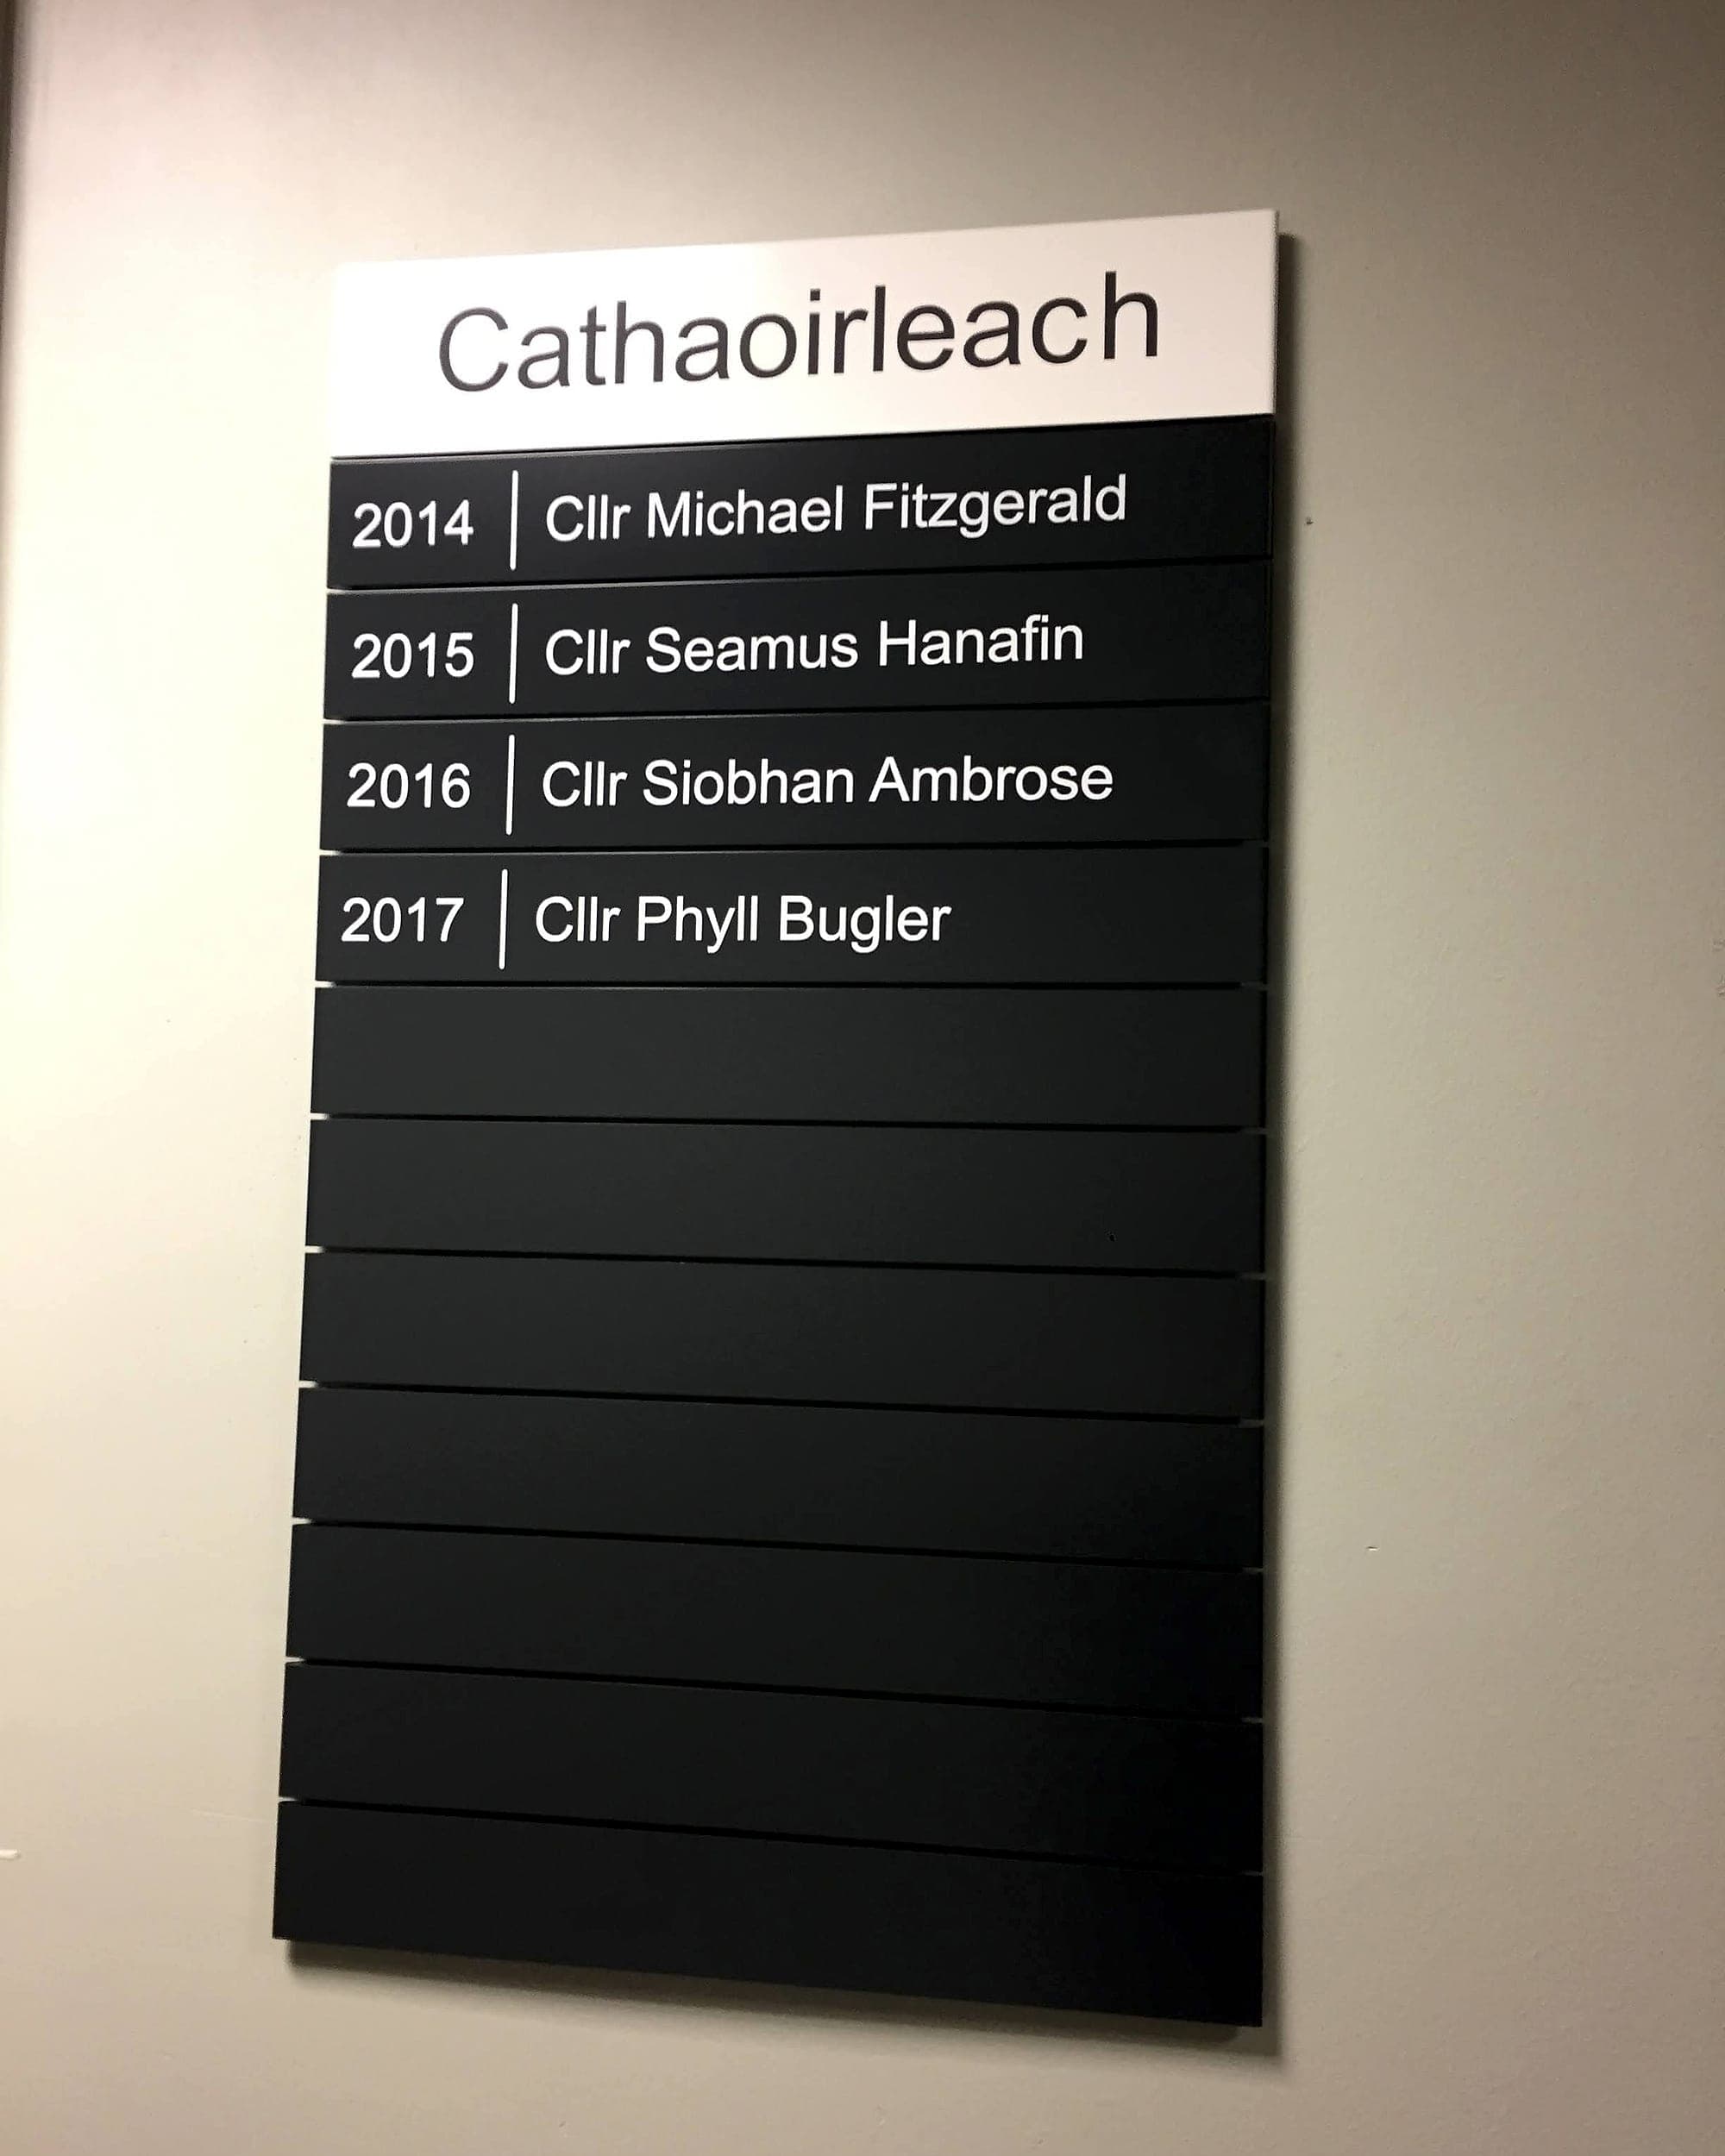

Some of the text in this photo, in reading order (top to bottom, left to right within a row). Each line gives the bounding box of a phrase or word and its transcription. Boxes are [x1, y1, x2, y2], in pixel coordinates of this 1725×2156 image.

[438, 270, 1159, 392] Cathaoirleach
[352, 473, 1126, 549] 2014 Cllr Michael Fitzgerald
[351, 613, 1083, 679] 2015 Cllr Seamus Hanafin
[346, 755, 1113, 810] 2016 Cllr Siobhan Ambrose
[341, 894, 952, 954] 2017 Cllr Phyll Bugler
